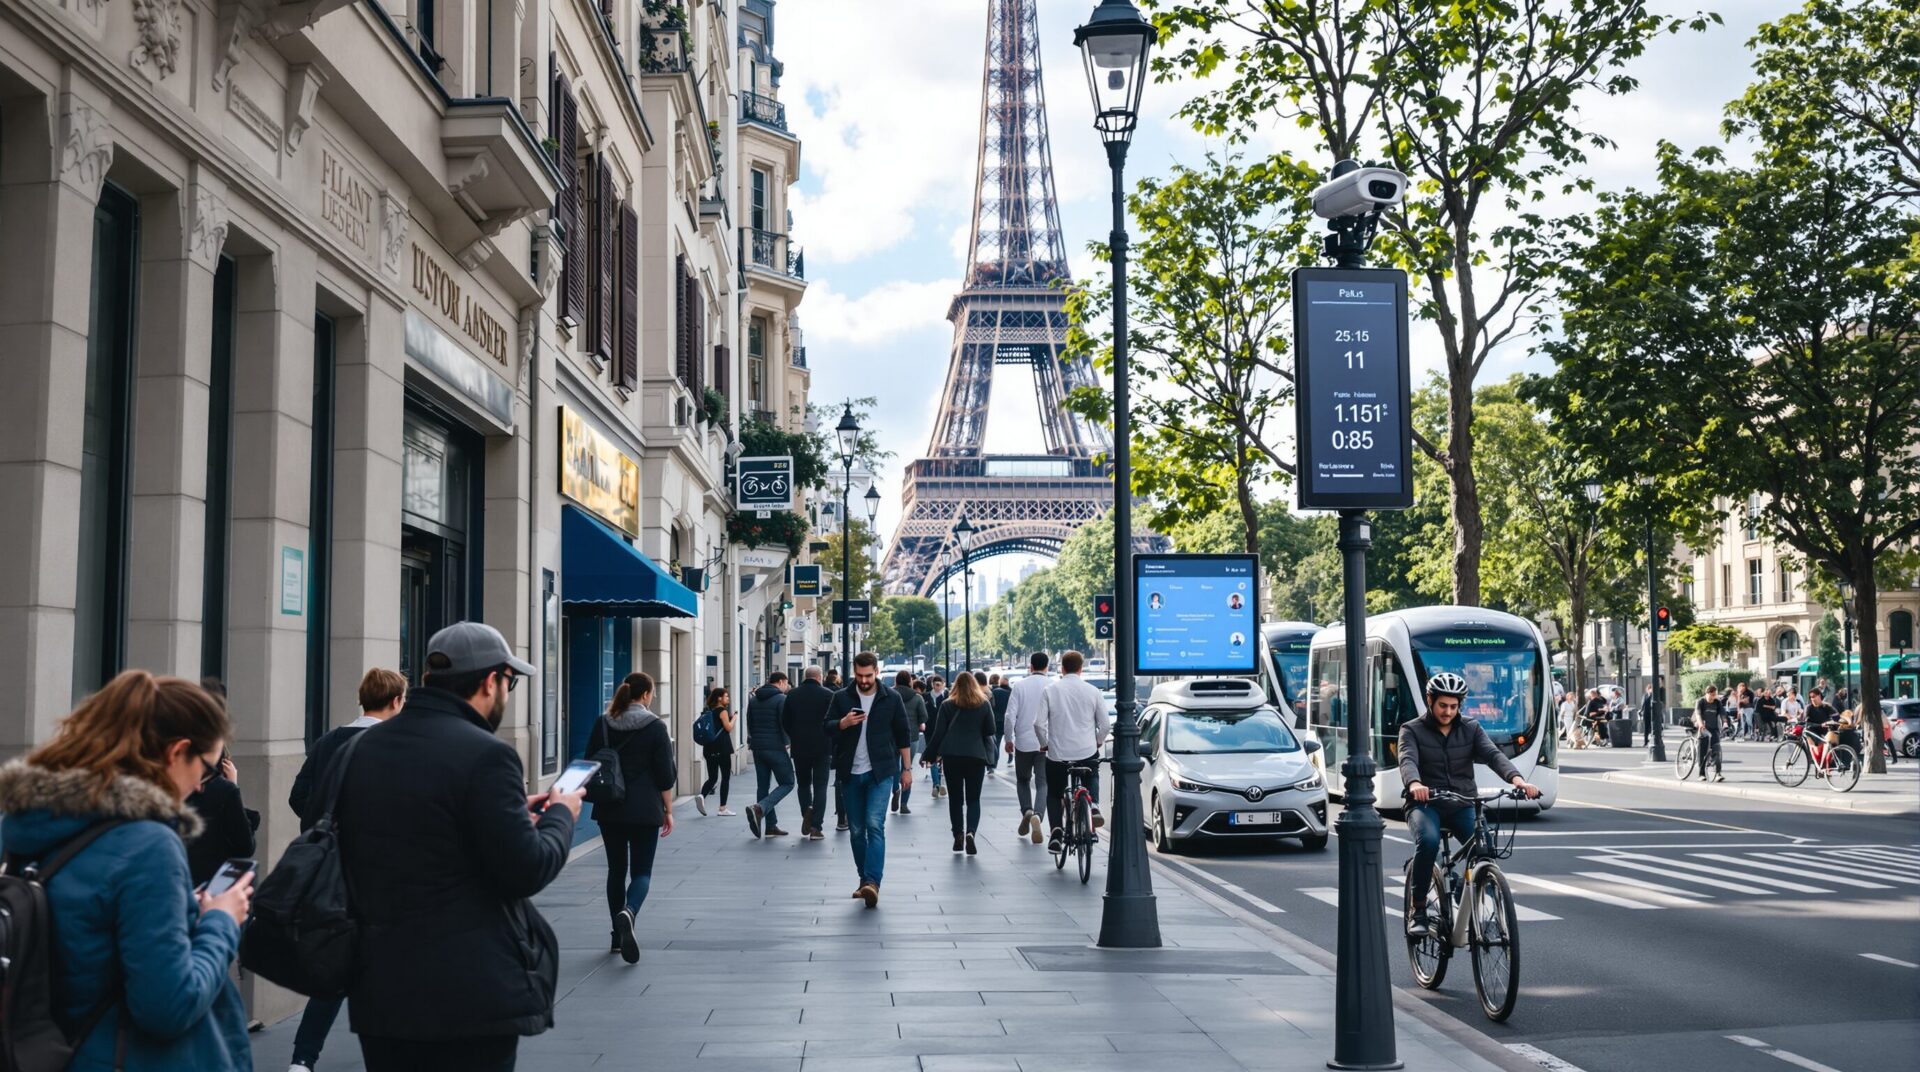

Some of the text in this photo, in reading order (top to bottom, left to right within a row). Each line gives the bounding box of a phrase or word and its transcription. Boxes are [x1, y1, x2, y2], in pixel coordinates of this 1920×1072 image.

[1335, 330, 1370, 342] 25:15
[1344, 351, 1364, 369] 11
[1332, 430, 1374, 450] 0:85
